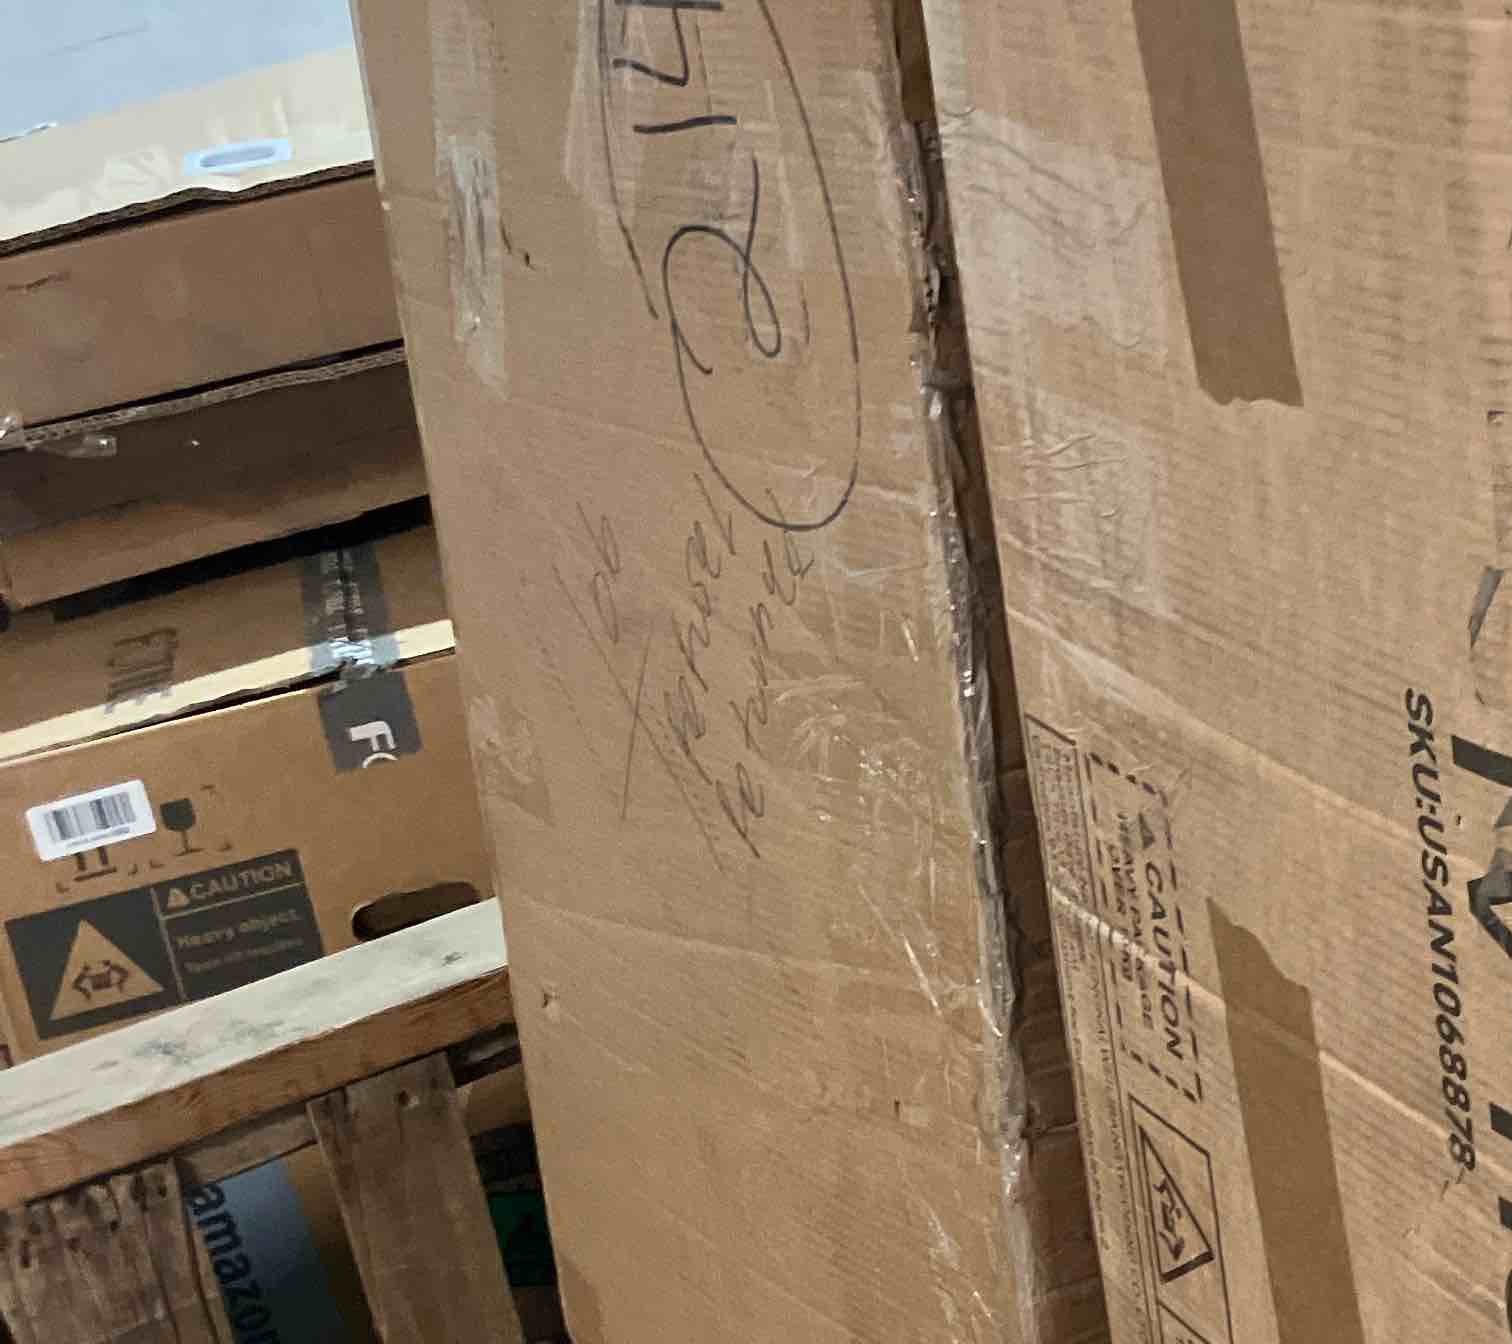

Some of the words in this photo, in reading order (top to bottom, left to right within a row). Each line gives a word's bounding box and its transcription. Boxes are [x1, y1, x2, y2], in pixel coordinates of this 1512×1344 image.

[191, 859, 293, 901] CAUTION
[1145, 860, 1184, 1061] CAUTION
[1403, 687, 1477, 1174] SKU:USAN1068878
